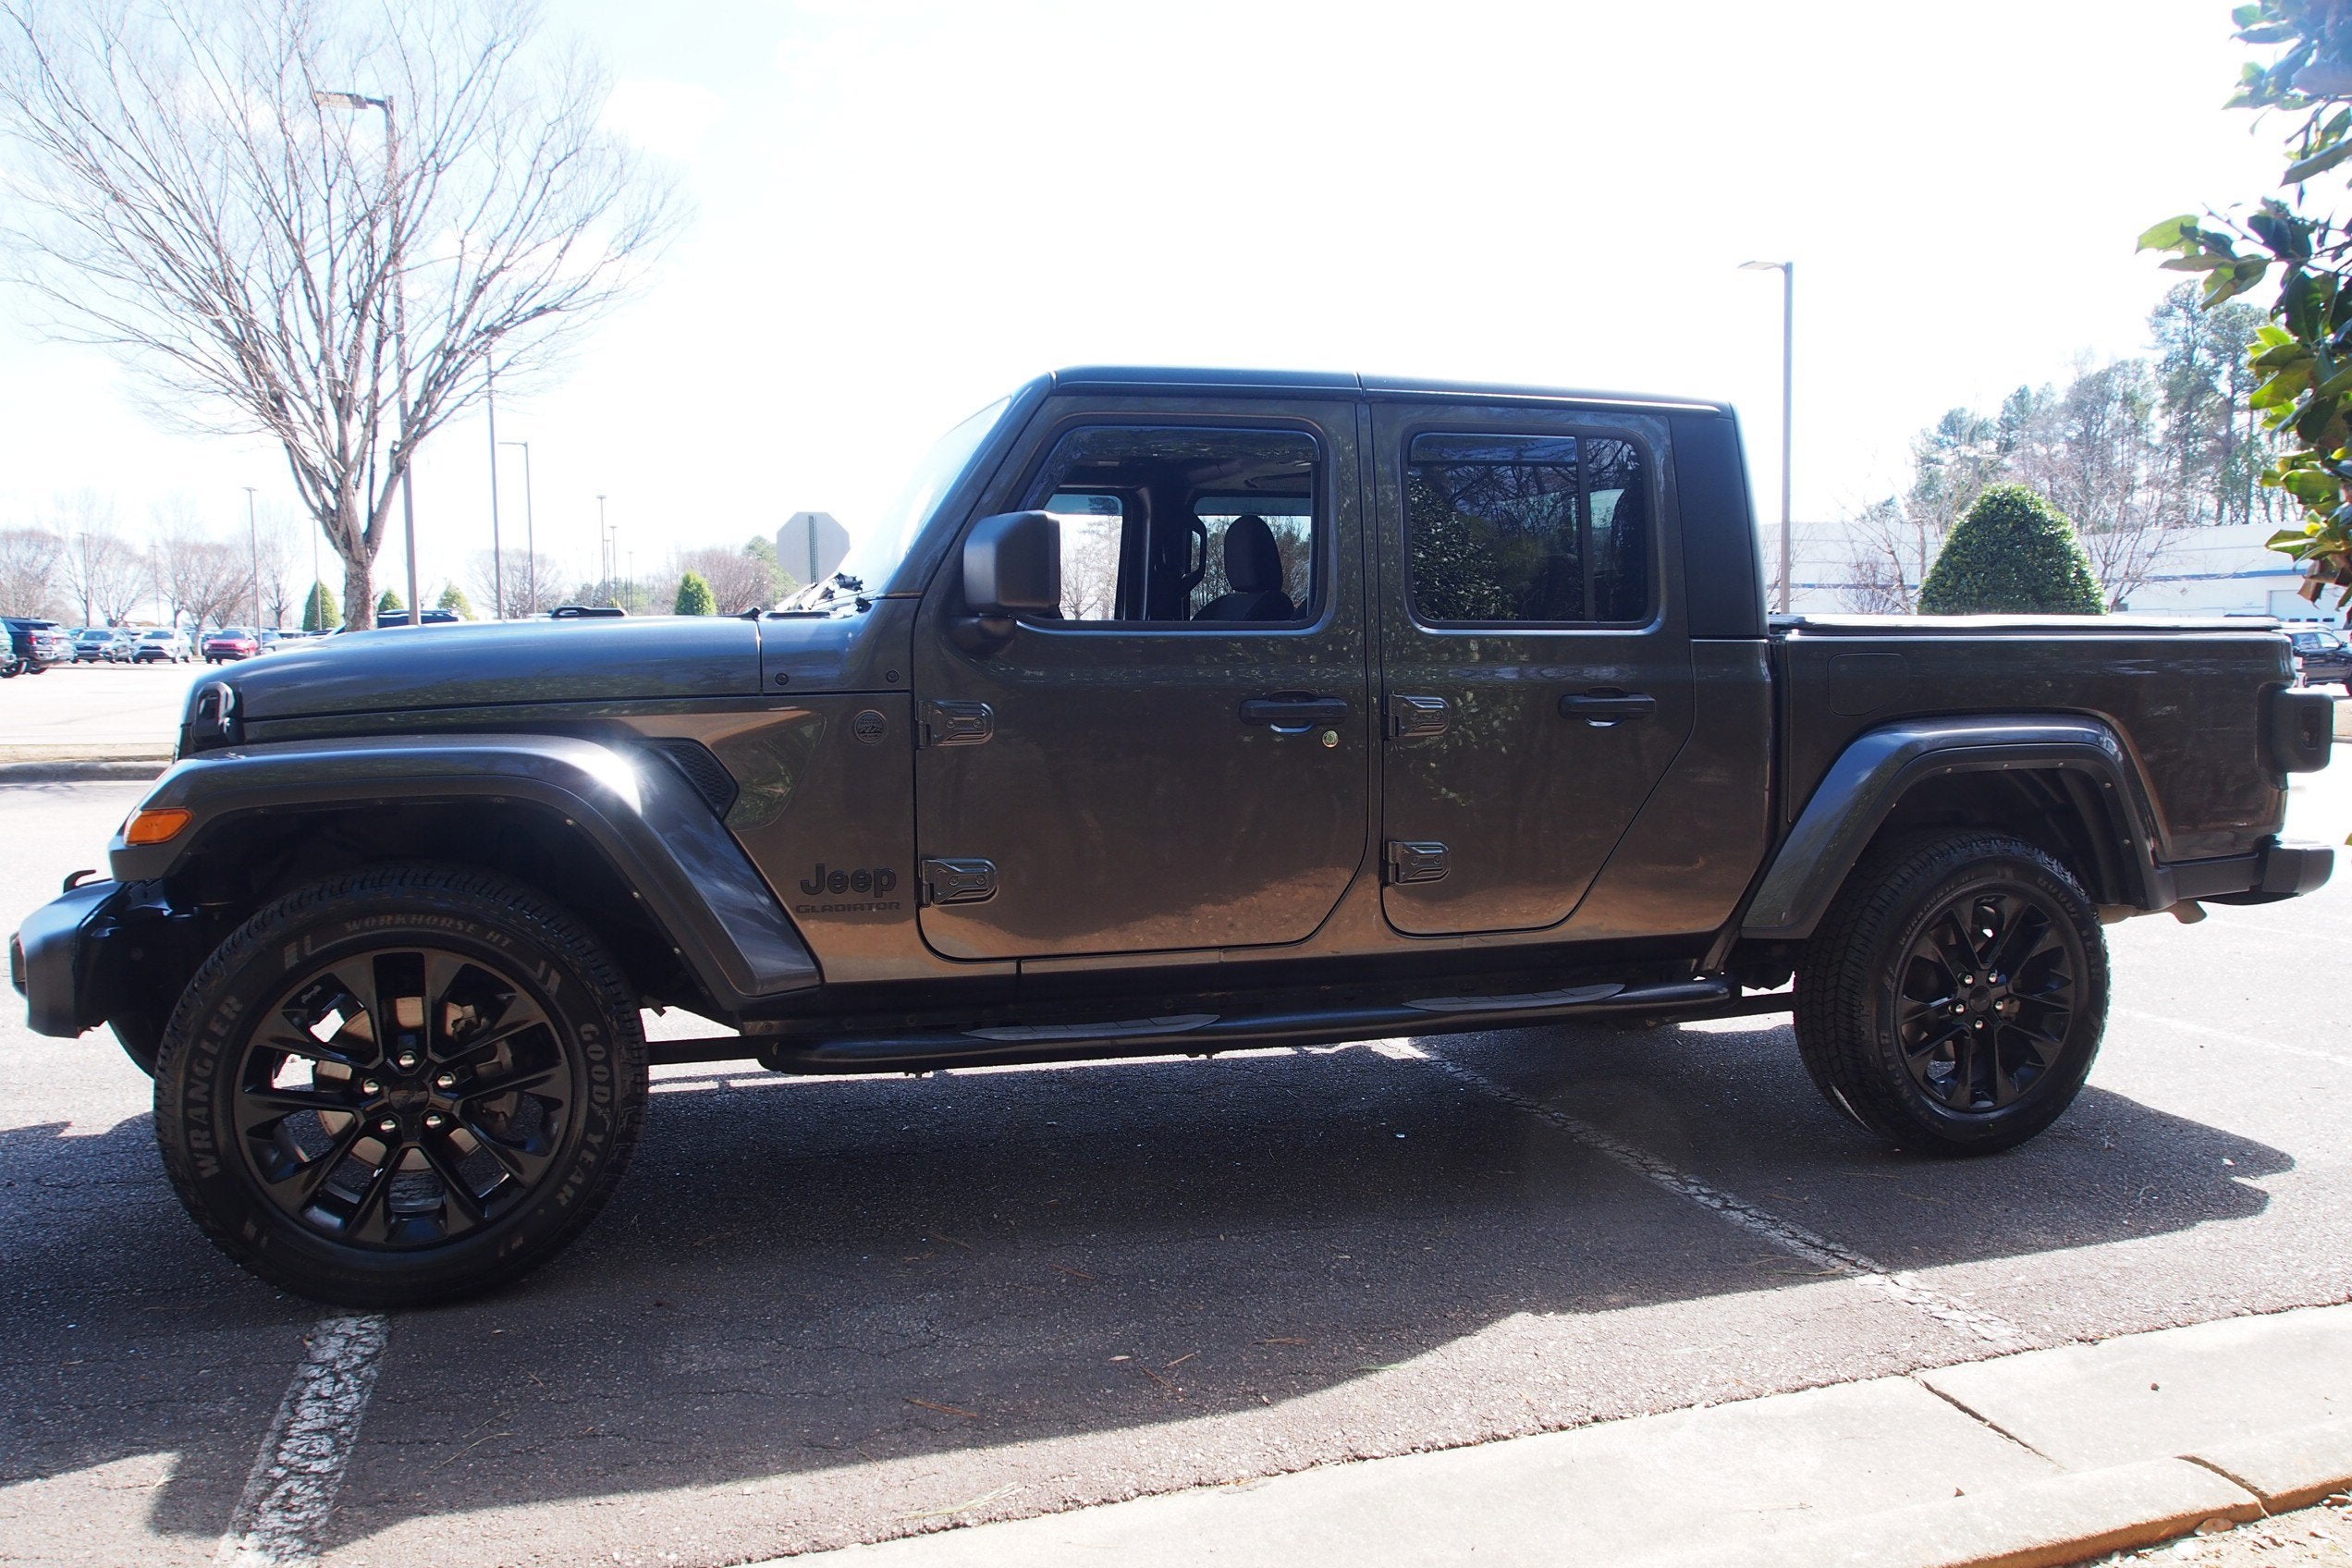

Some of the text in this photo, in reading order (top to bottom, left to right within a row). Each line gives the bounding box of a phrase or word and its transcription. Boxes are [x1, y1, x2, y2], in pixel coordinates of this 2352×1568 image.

[801, 863, 897, 898] Jeep
[795, 901, 901, 913] GLADIATOR
[344, 913, 514, 948] WORKHORSE HT
[187, 995, 244, 1179] WRANGLER
